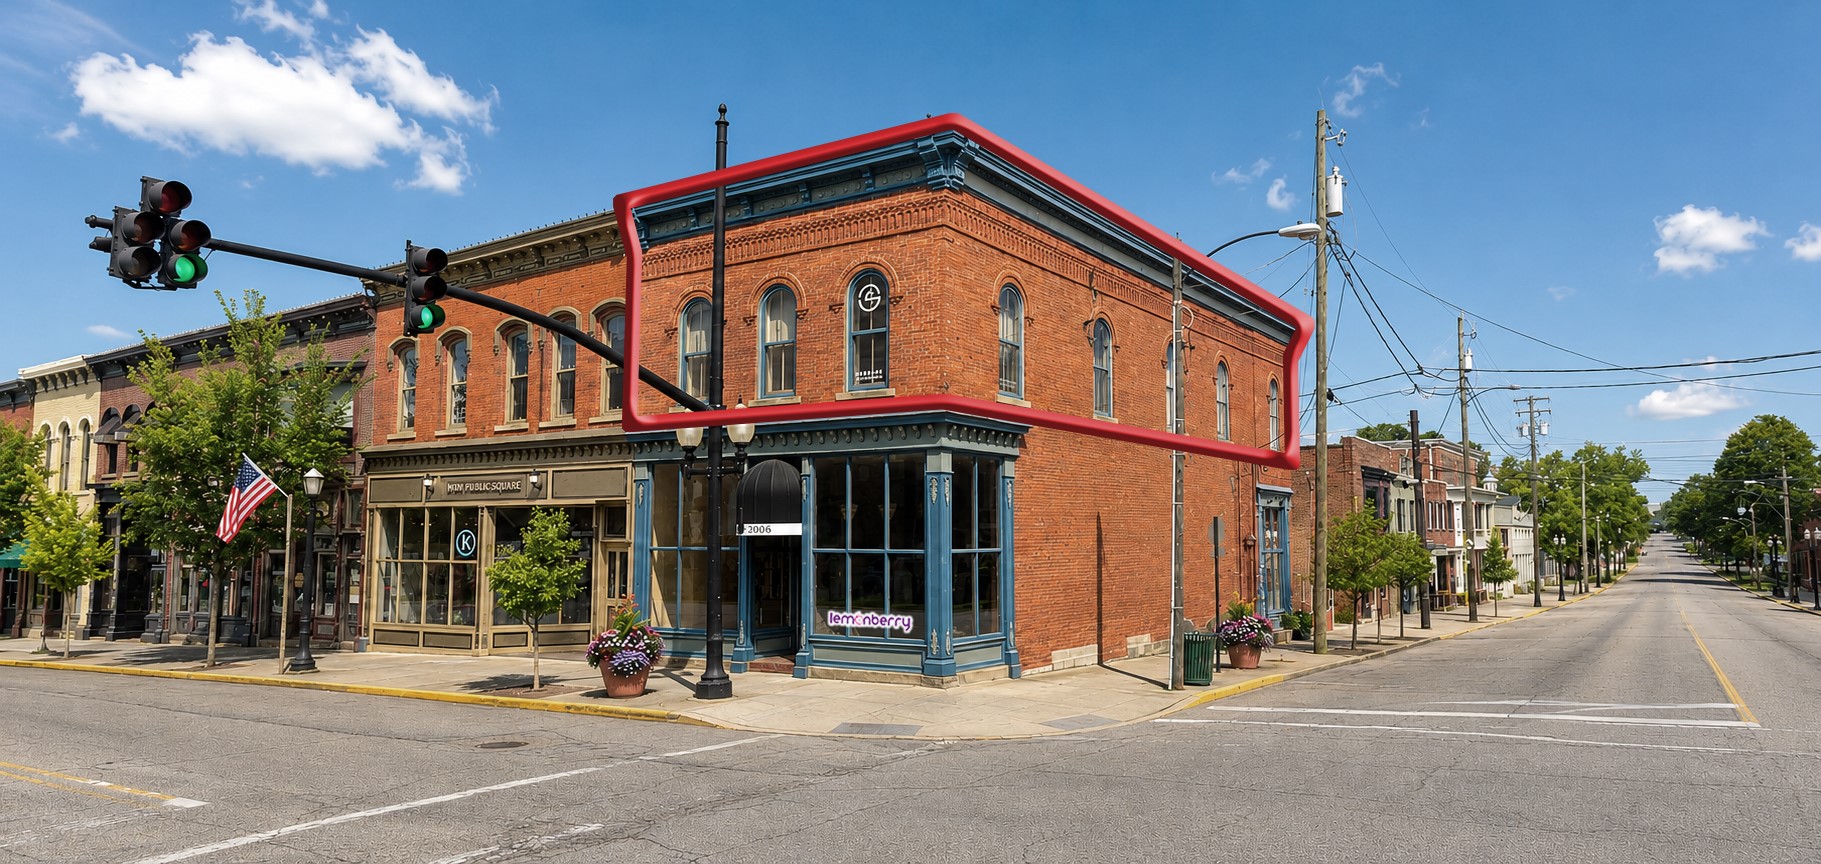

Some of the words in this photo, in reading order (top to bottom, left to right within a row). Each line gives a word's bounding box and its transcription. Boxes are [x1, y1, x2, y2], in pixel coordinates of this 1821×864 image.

[465, 482, 491, 491] PUBLIC
[491, 481, 521, 492] SQUARE
[829, 612, 911, 631] lemonberry
